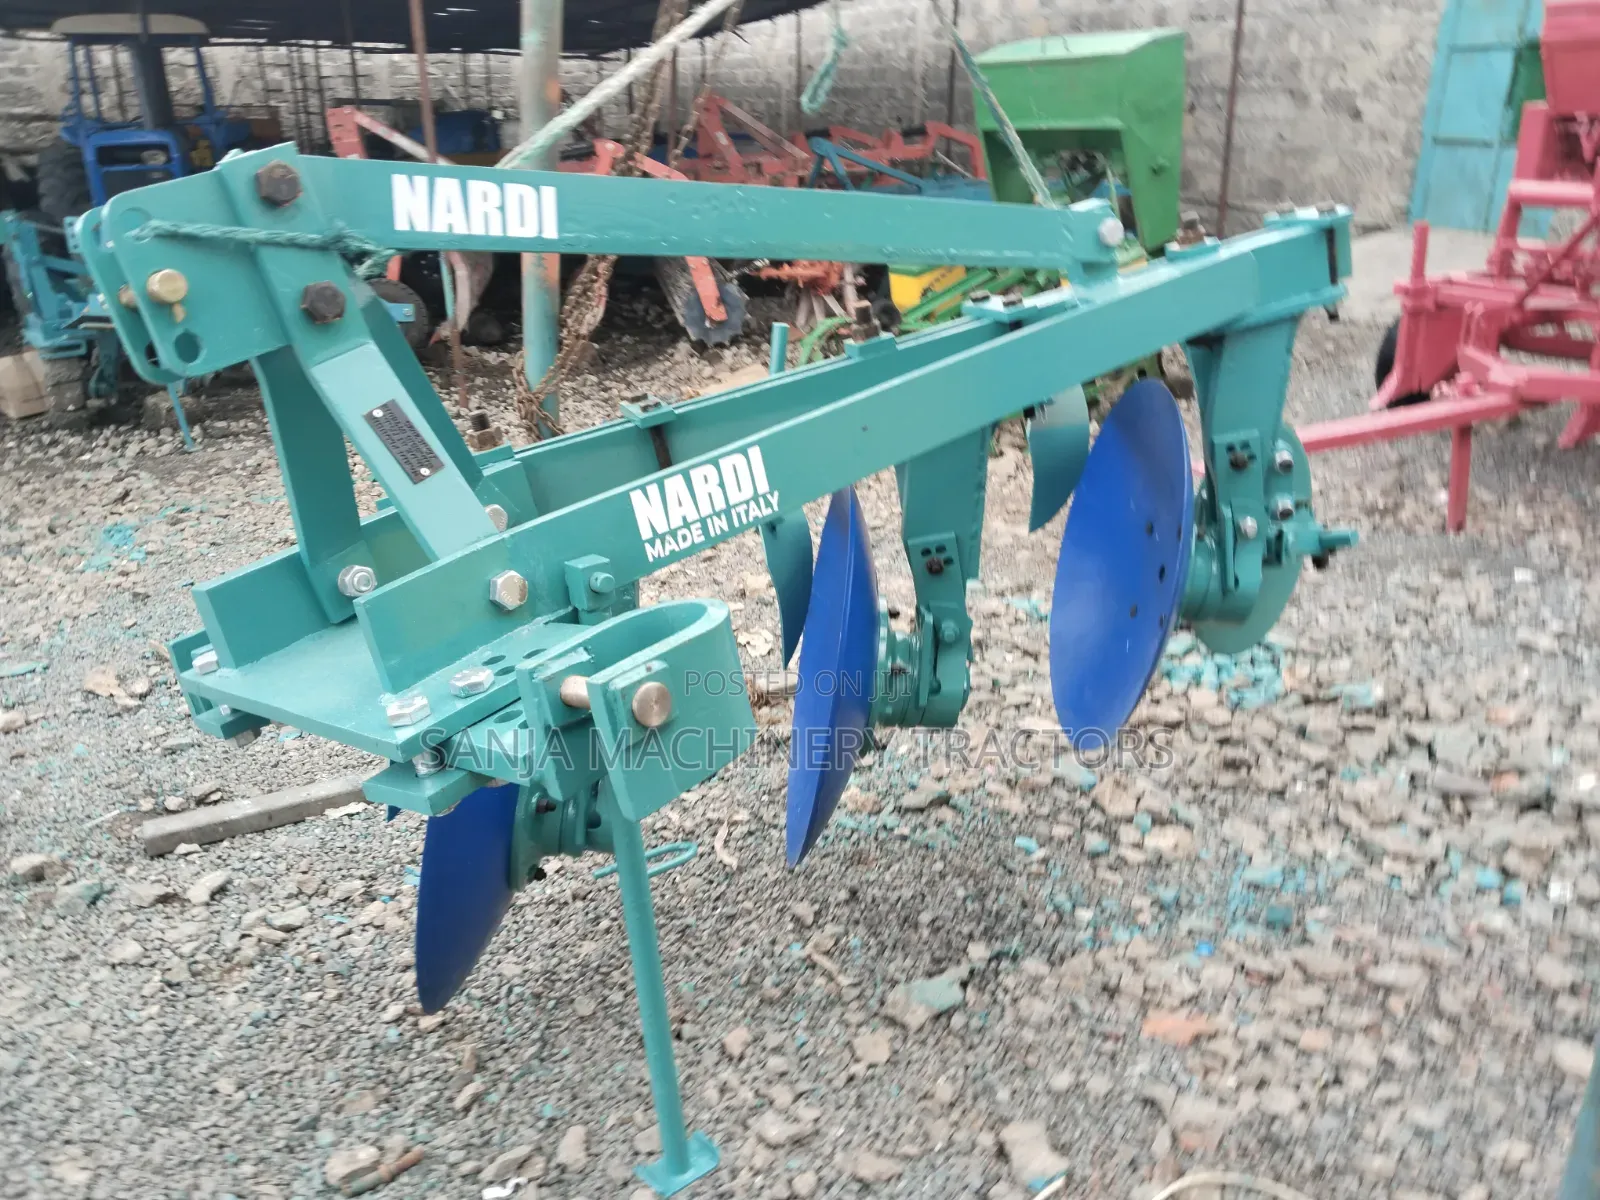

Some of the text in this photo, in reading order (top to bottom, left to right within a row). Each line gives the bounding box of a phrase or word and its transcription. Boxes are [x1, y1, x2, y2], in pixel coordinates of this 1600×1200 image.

[391, 173, 559, 239] NARDI
[629, 444, 770, 541] NARDI
[643, 490, 780, 562] MADE IN ITALY
